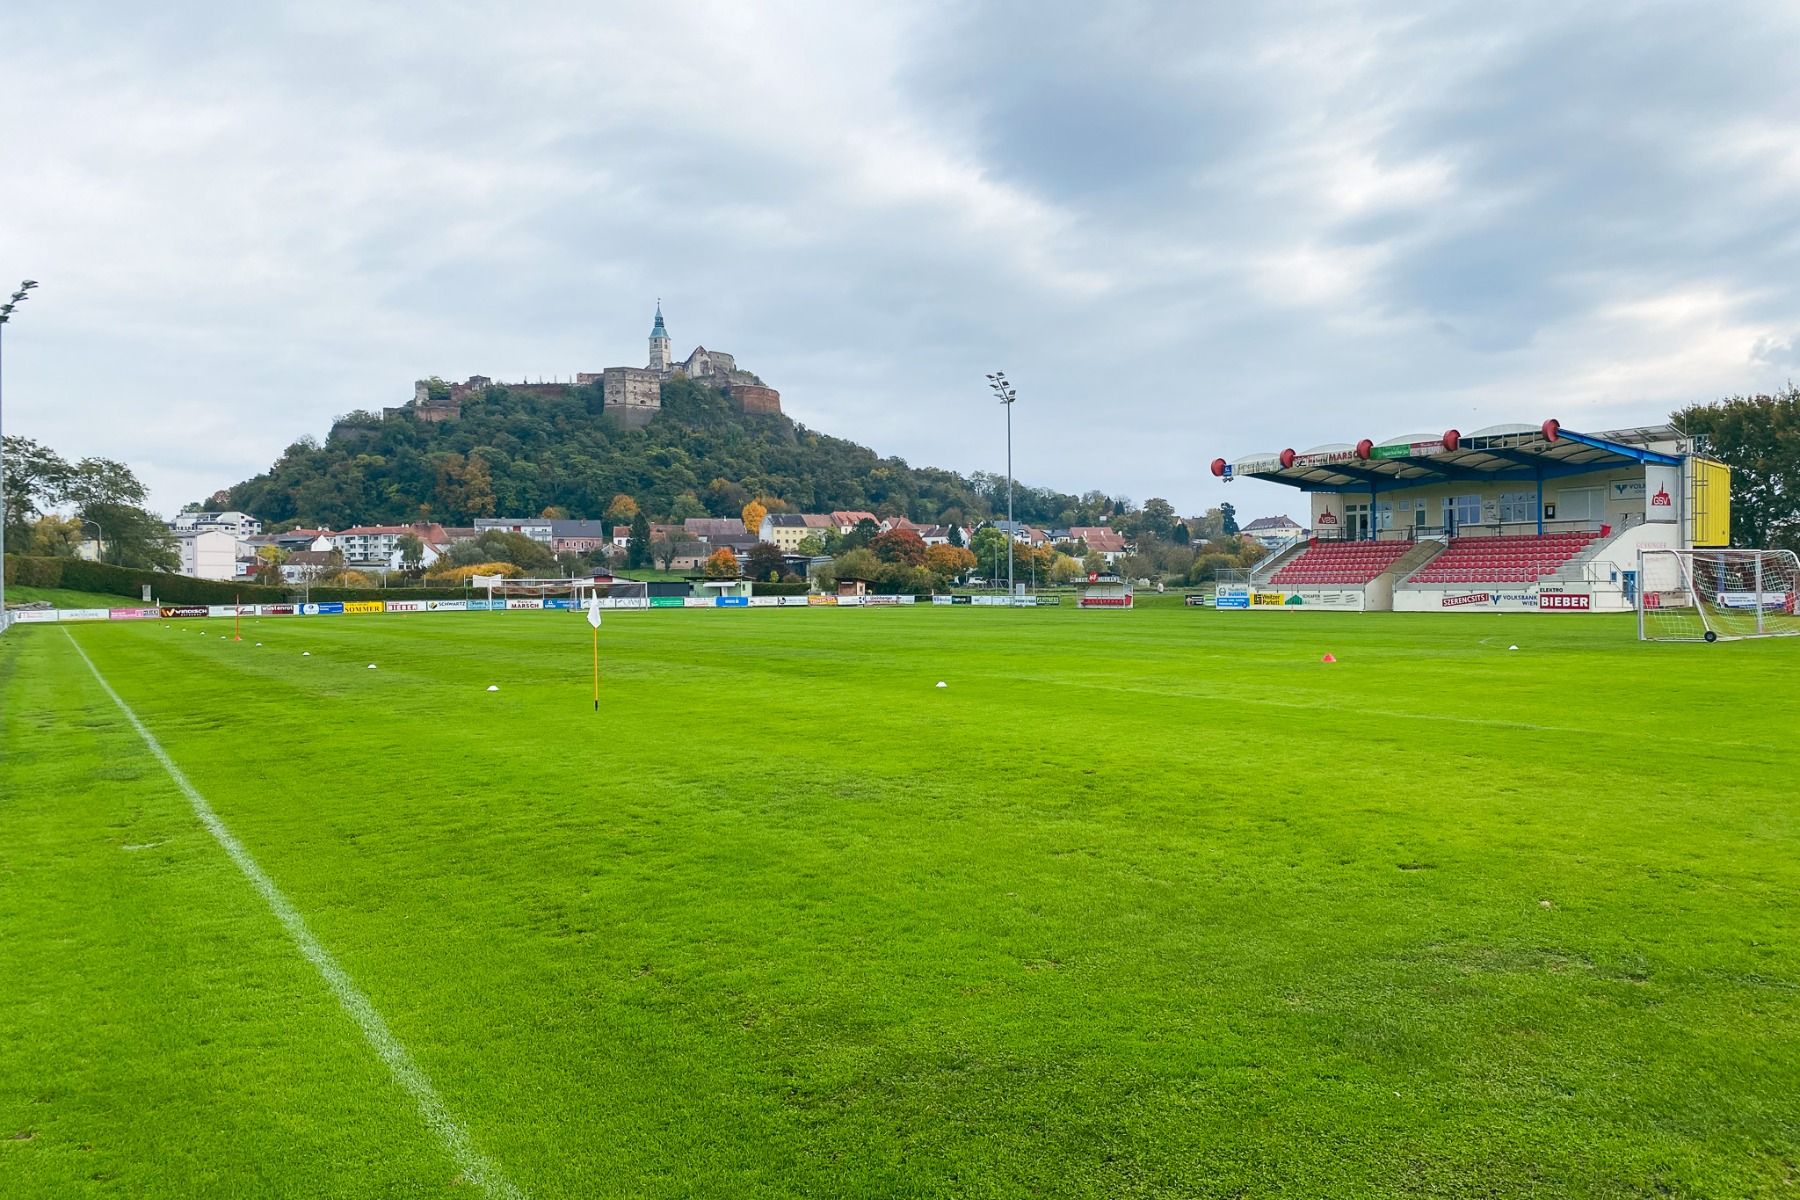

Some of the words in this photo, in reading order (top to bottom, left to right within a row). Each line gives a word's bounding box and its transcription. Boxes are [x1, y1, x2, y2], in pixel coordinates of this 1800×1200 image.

[1329, 450, 1358, 462] MARSC
[1653, 496, 1669, 505] GSV
[1541, 596, 1588, 607] BIEBER
